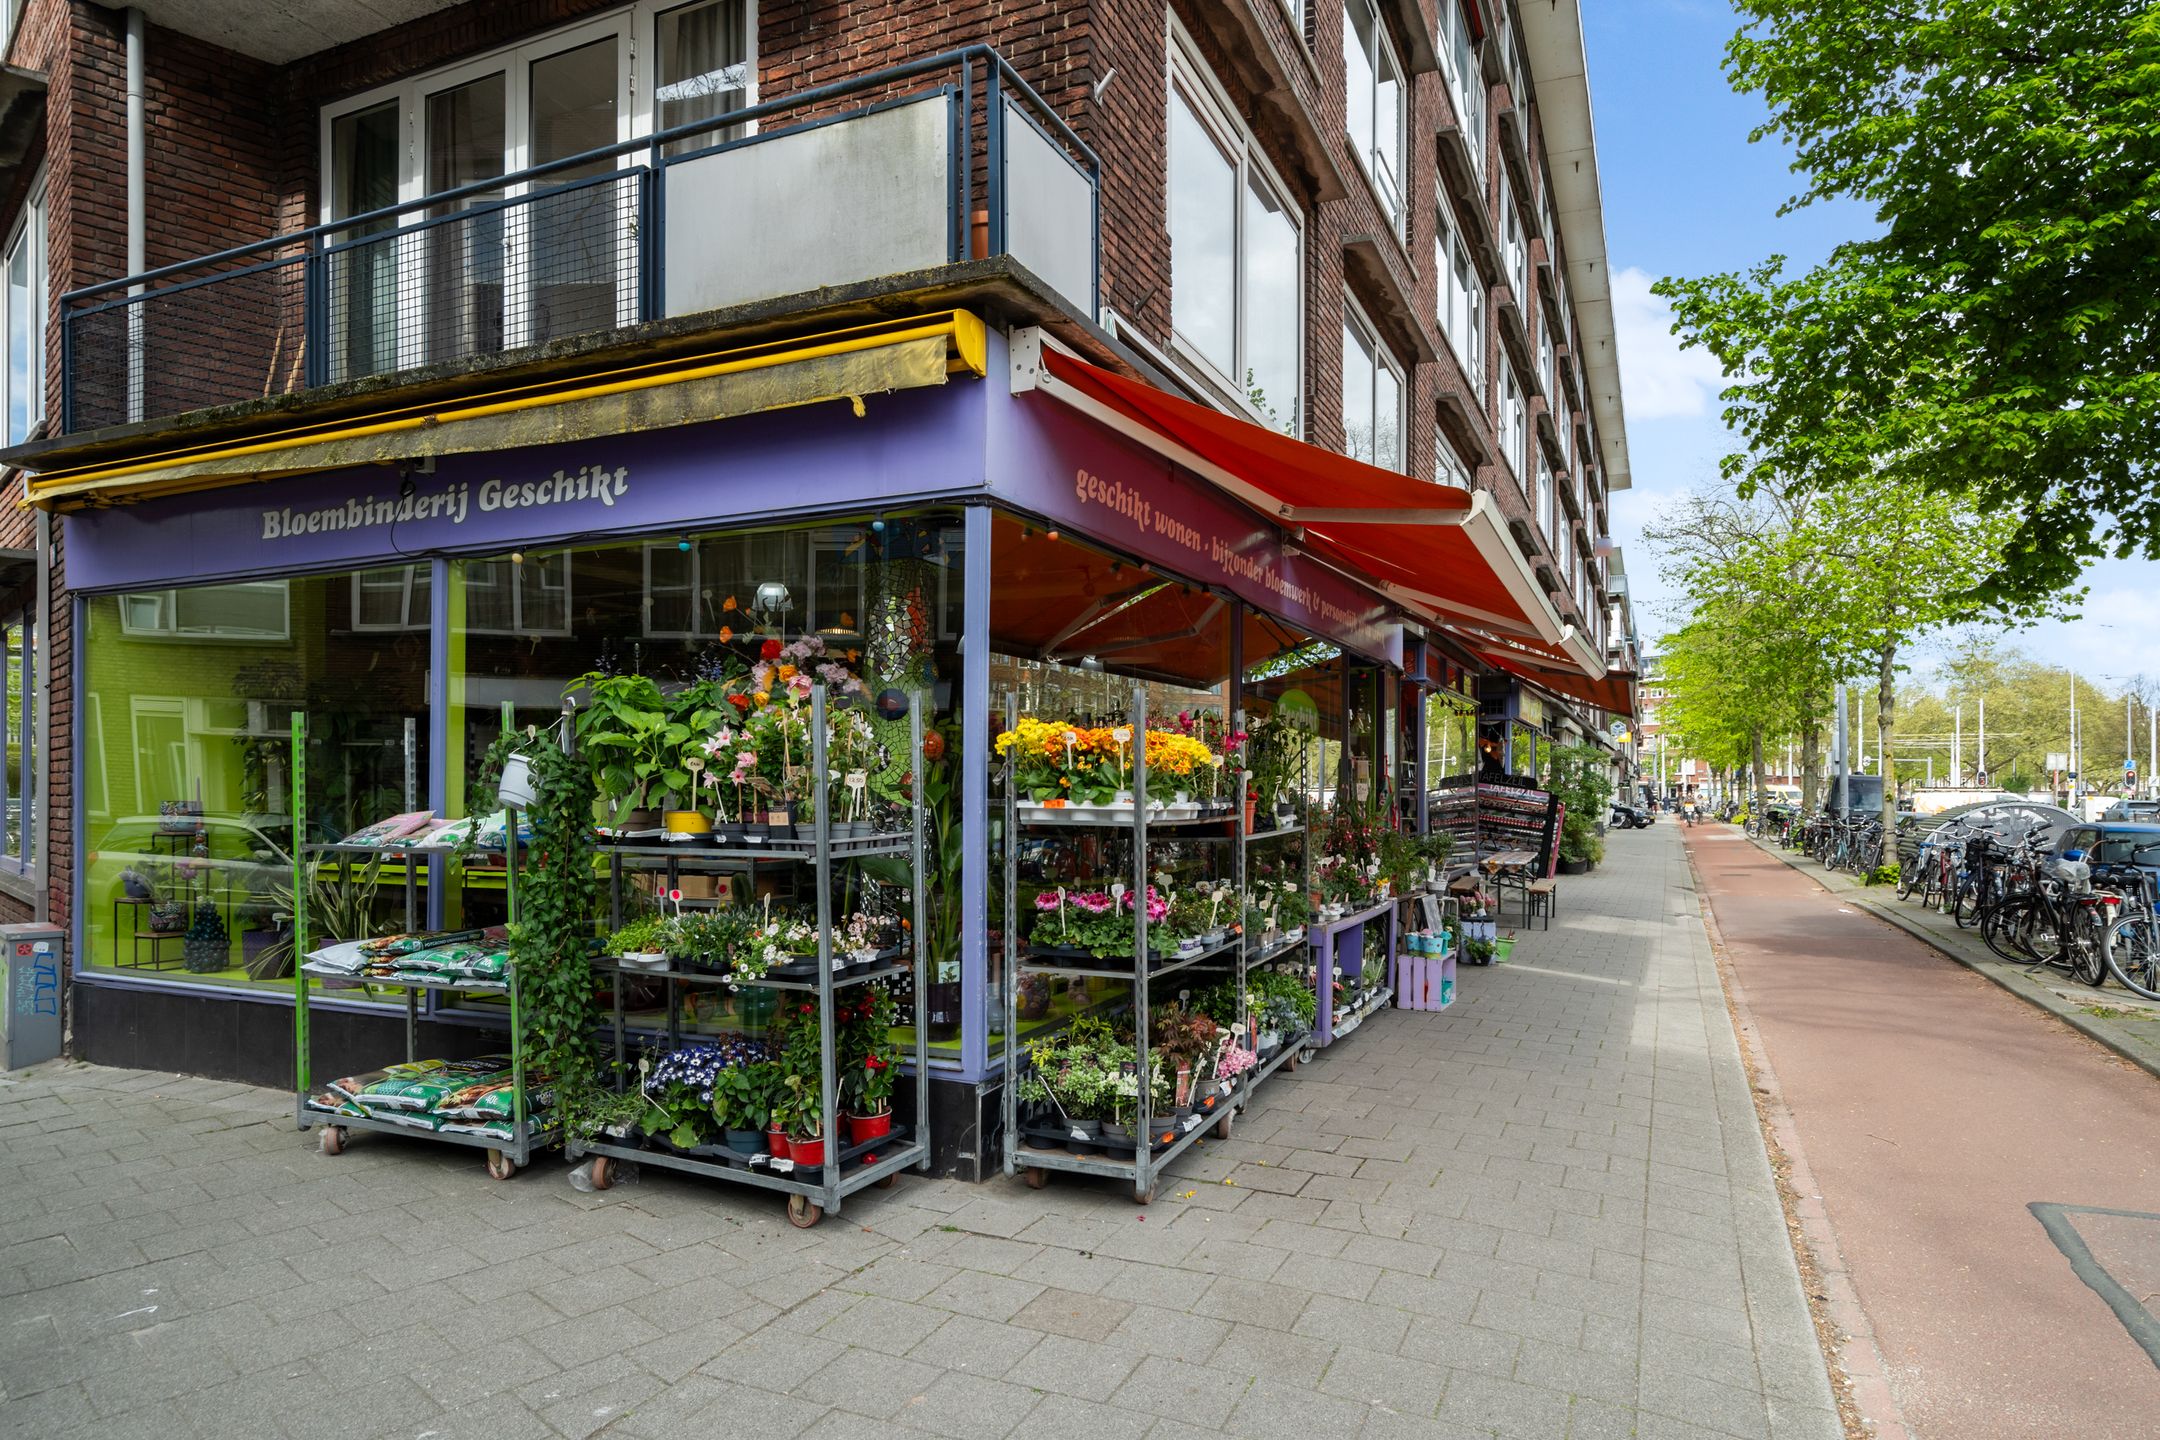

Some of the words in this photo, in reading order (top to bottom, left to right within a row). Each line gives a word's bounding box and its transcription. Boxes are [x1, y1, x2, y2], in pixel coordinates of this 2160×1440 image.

[261, 482, 469, 540] Bloembinderij
[478, 465, 629, 512] Geschikt
[1076, 468, 1151, 533] geschikt
[1154, 510, 1201, 552] wonen
[1211, 535, 1264, 584] bijzonder
[1265, 565, 1312, 614] bloemwerk
